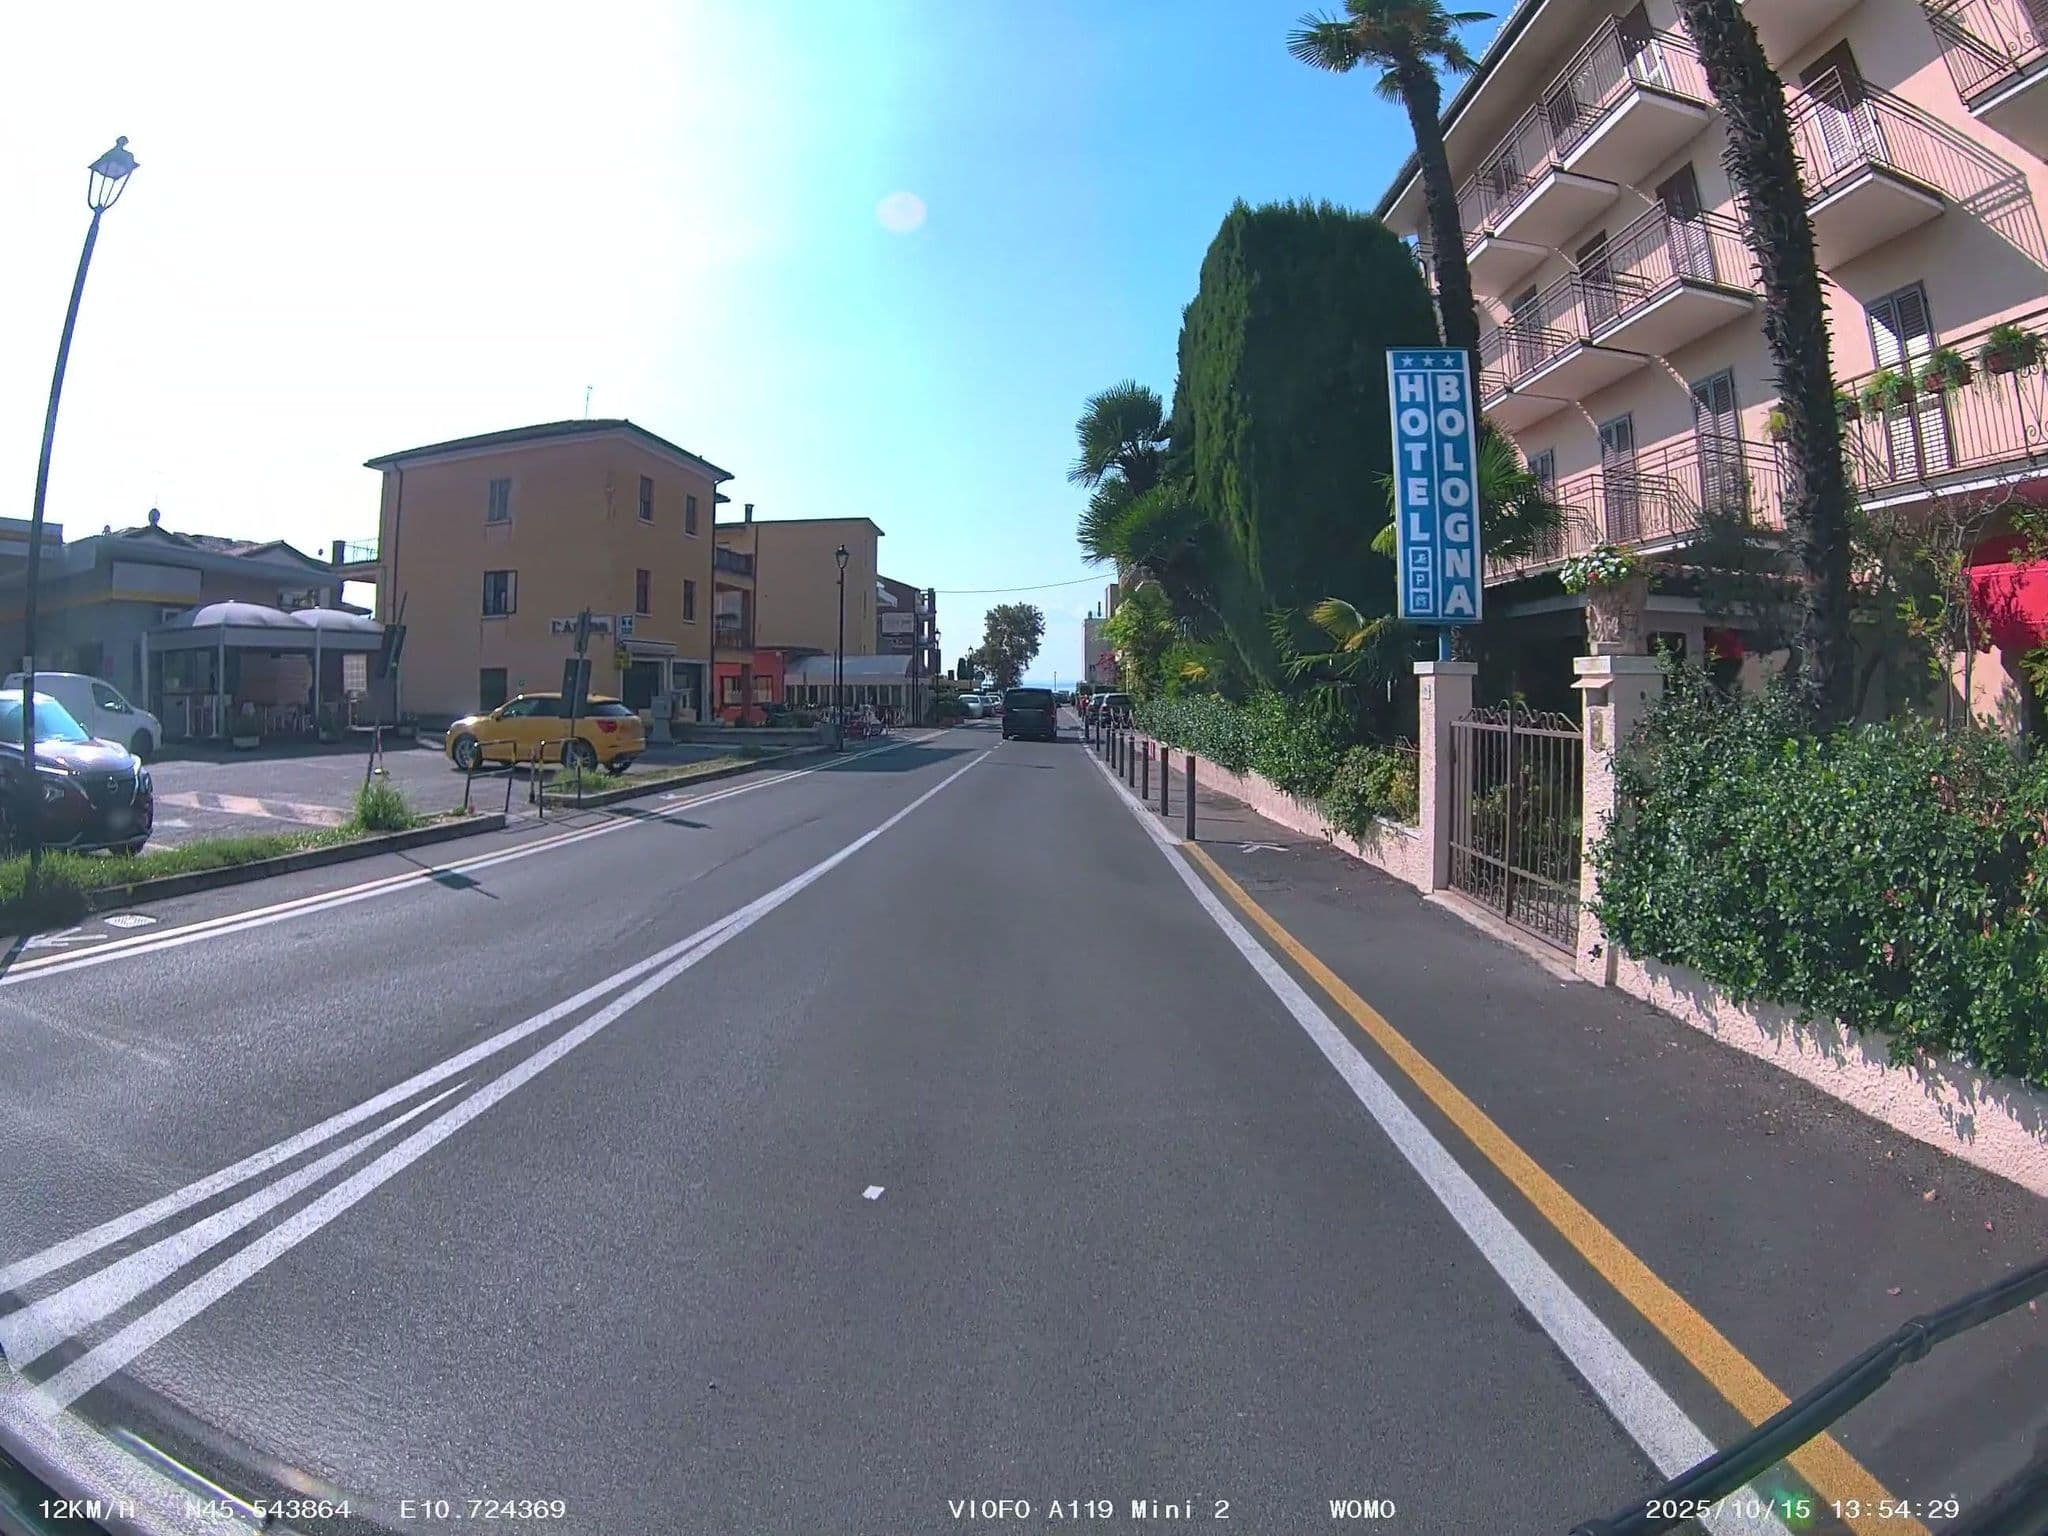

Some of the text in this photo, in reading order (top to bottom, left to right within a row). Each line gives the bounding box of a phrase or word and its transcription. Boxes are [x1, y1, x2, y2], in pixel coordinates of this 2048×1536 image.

[1399, 375, 1430, 542] HOTEL
[1437, 374, 1474, 615] BOLOGNA
[1415, 573, 1426, 587] P
